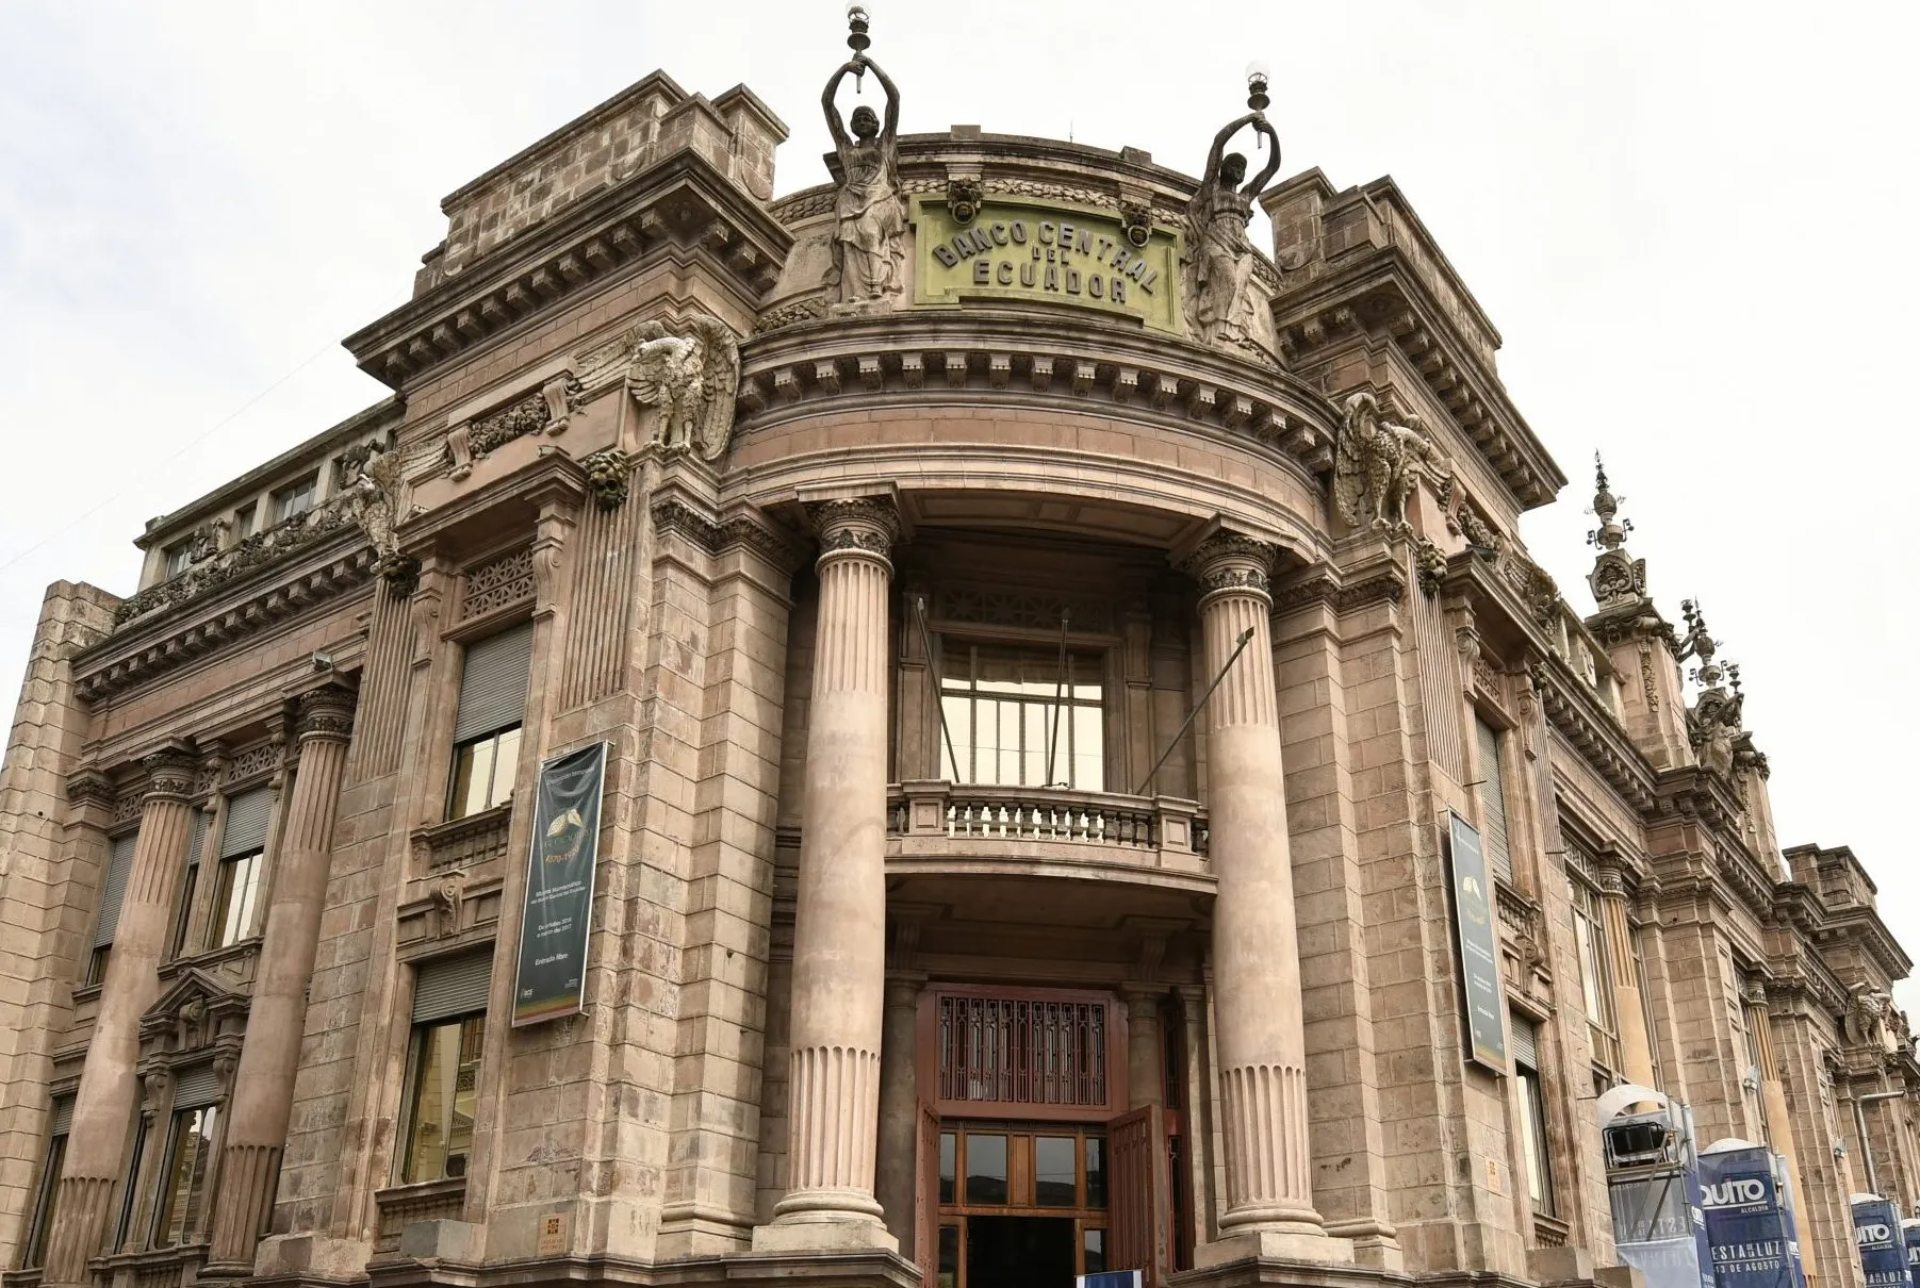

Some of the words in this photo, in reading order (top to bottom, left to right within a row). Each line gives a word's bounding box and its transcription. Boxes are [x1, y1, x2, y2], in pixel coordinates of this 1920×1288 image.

[932, 219, 1028, 268] BANCO
[1038, 221, 1158, 294] CENTRAL
[1032, 246, 1069, 265] DEL
[973, 259, 1127, 304] ECUADOR
[1756, 1241, 1782, 1257] LUZ
[1730, 1263, 1742, 1273] DE
[1745, 1261, 1780, 1272] AGOSTO
